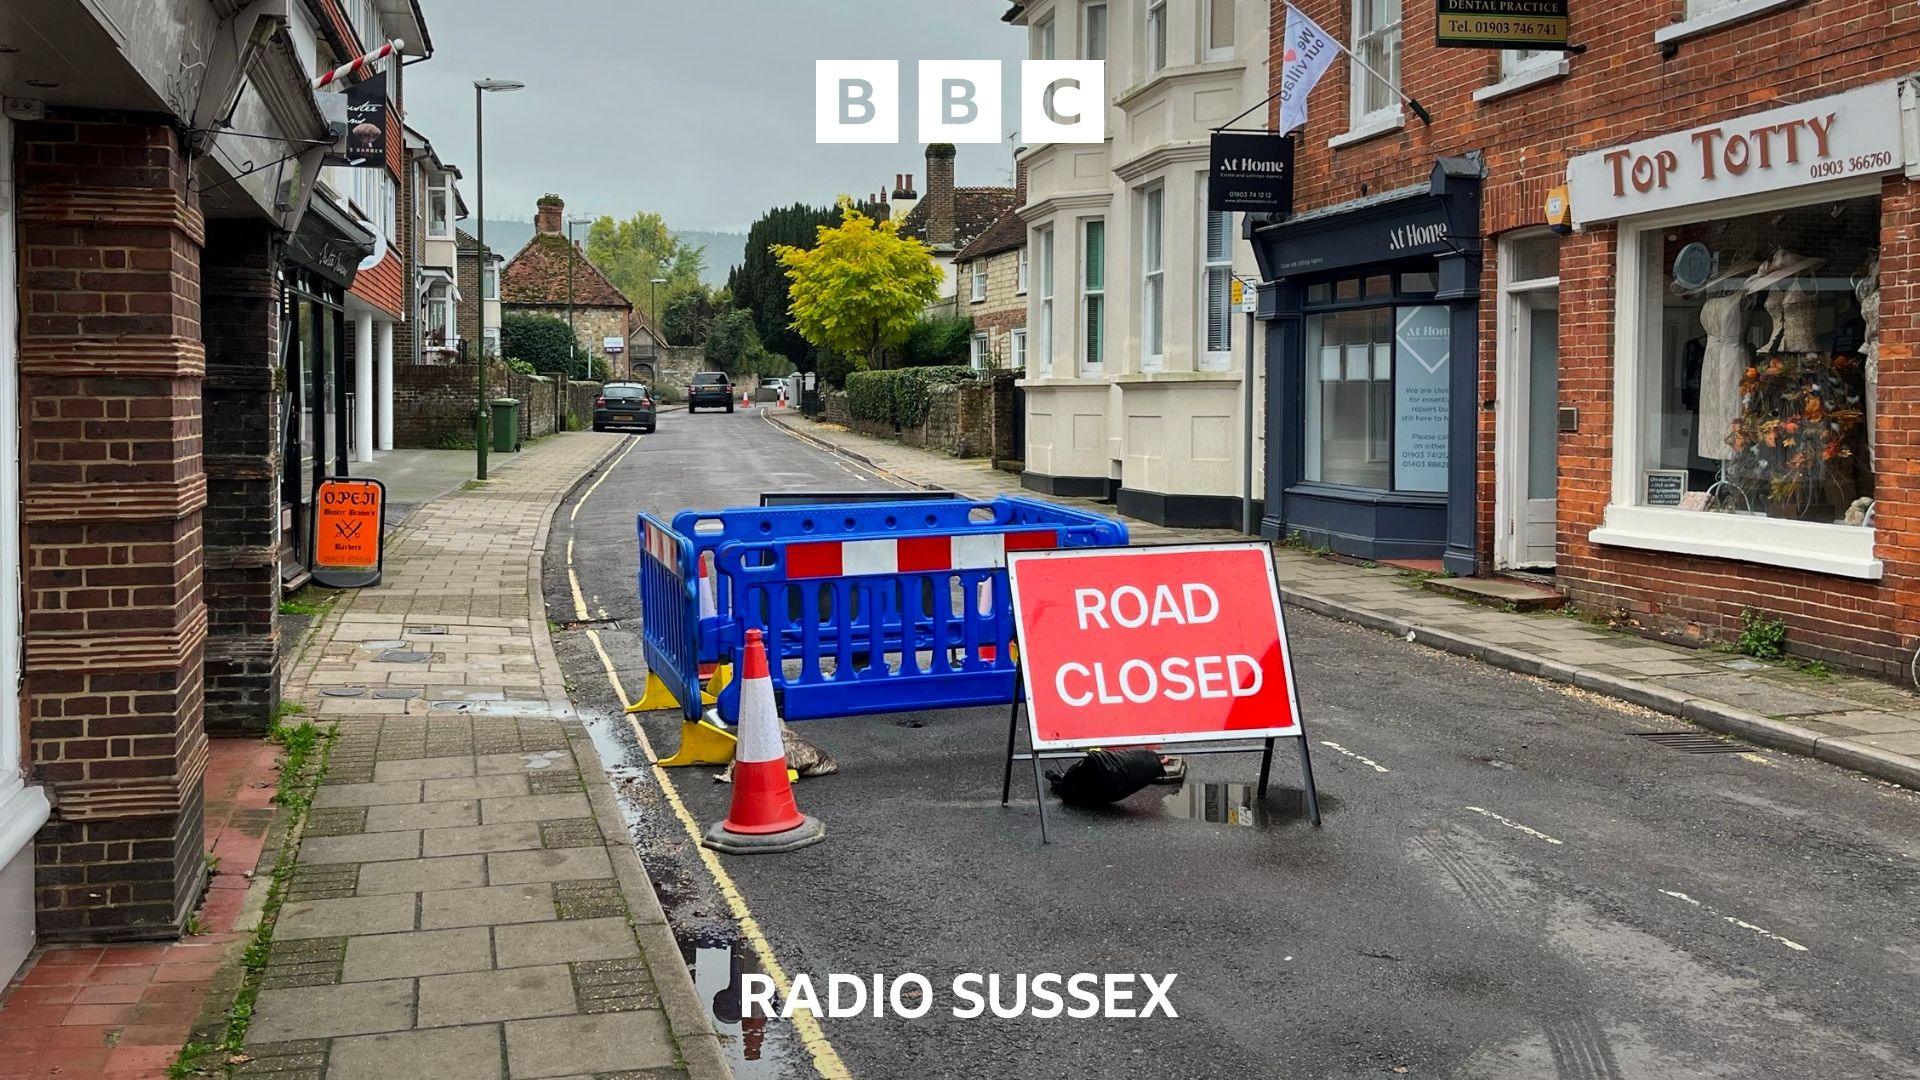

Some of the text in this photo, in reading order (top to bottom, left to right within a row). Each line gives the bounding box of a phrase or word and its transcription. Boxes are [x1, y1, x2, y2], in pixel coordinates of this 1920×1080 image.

[1449, 0, 1558, 13] DENTAL PRACTICE
[1449, 20, 1557, 35] Tel. 01903 746 741
[347, 101, 383, 112] uster
[1220, 158, 1284, 172] At Home
[1810, 151, 1892, 179] 01903 366760
[1390, 222, 1448, 251] At Home
[1407, 326, 1450, 337] At Hom
[1402, 451, 1425, 459] 01903
[324, 491, 375, 505] OPEN
[1074, 583, 1220, 630] ROAD
[1055, 654, 1263, 707] CLOSED
